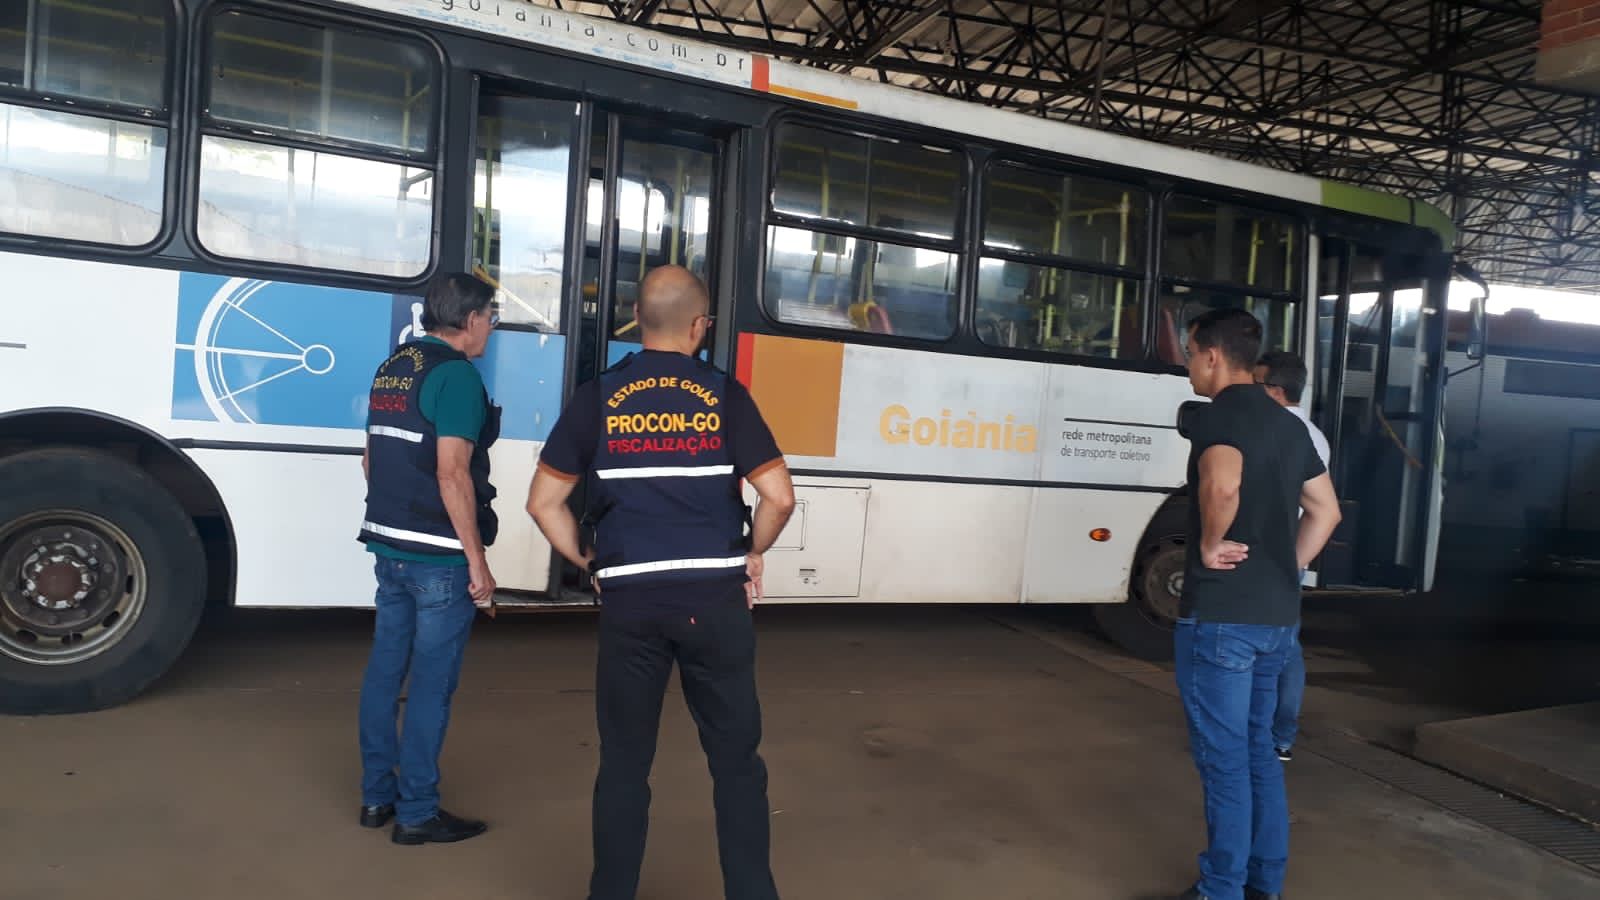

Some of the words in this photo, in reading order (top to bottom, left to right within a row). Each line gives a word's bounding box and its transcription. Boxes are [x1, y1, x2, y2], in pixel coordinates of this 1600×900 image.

[607, 377, 656, 408] ESTADO
[659, 377, 678, 388] DE
[680, 379, 719, 407] GOIÁS
[606, 412, 721, 434] PROCON-GO
[608, 432, 721, 455] FISCALIZAÇÃO
[1062, 427, 1084, 440] rede
[1086, 432, 1152, 446] metropolitana
[1060, 443, 1073, 457] de
[1074, 447, 1117, 461] transporte
[1119, 449, 1151, 461] coletivo
